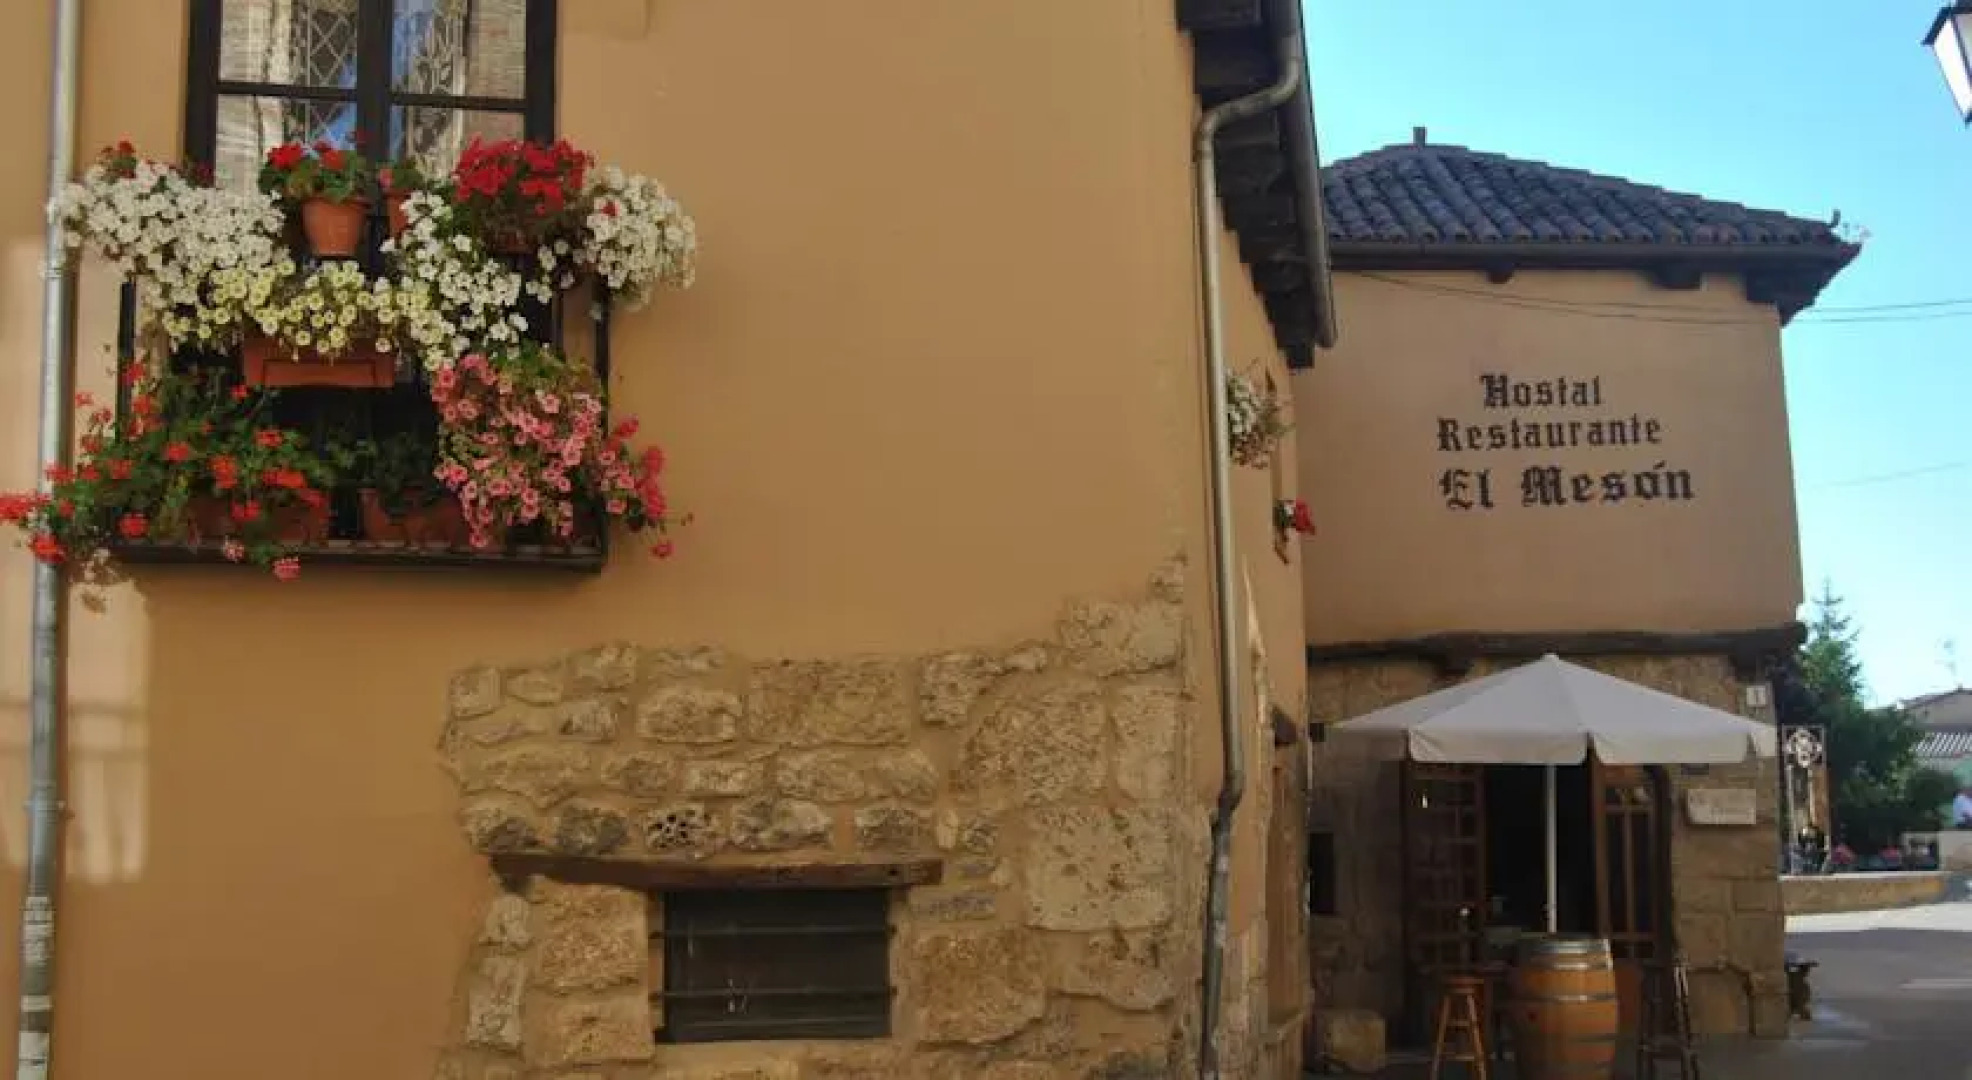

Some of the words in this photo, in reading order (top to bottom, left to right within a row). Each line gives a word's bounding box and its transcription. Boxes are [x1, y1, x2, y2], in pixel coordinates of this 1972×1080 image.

[1480, 373, 1604, 408] Hostal
[1436, 413, 1663, 451] Restaurante
[1439, 467, 1494, 511] El
[1520, 460, 1696, 507] Mesón
